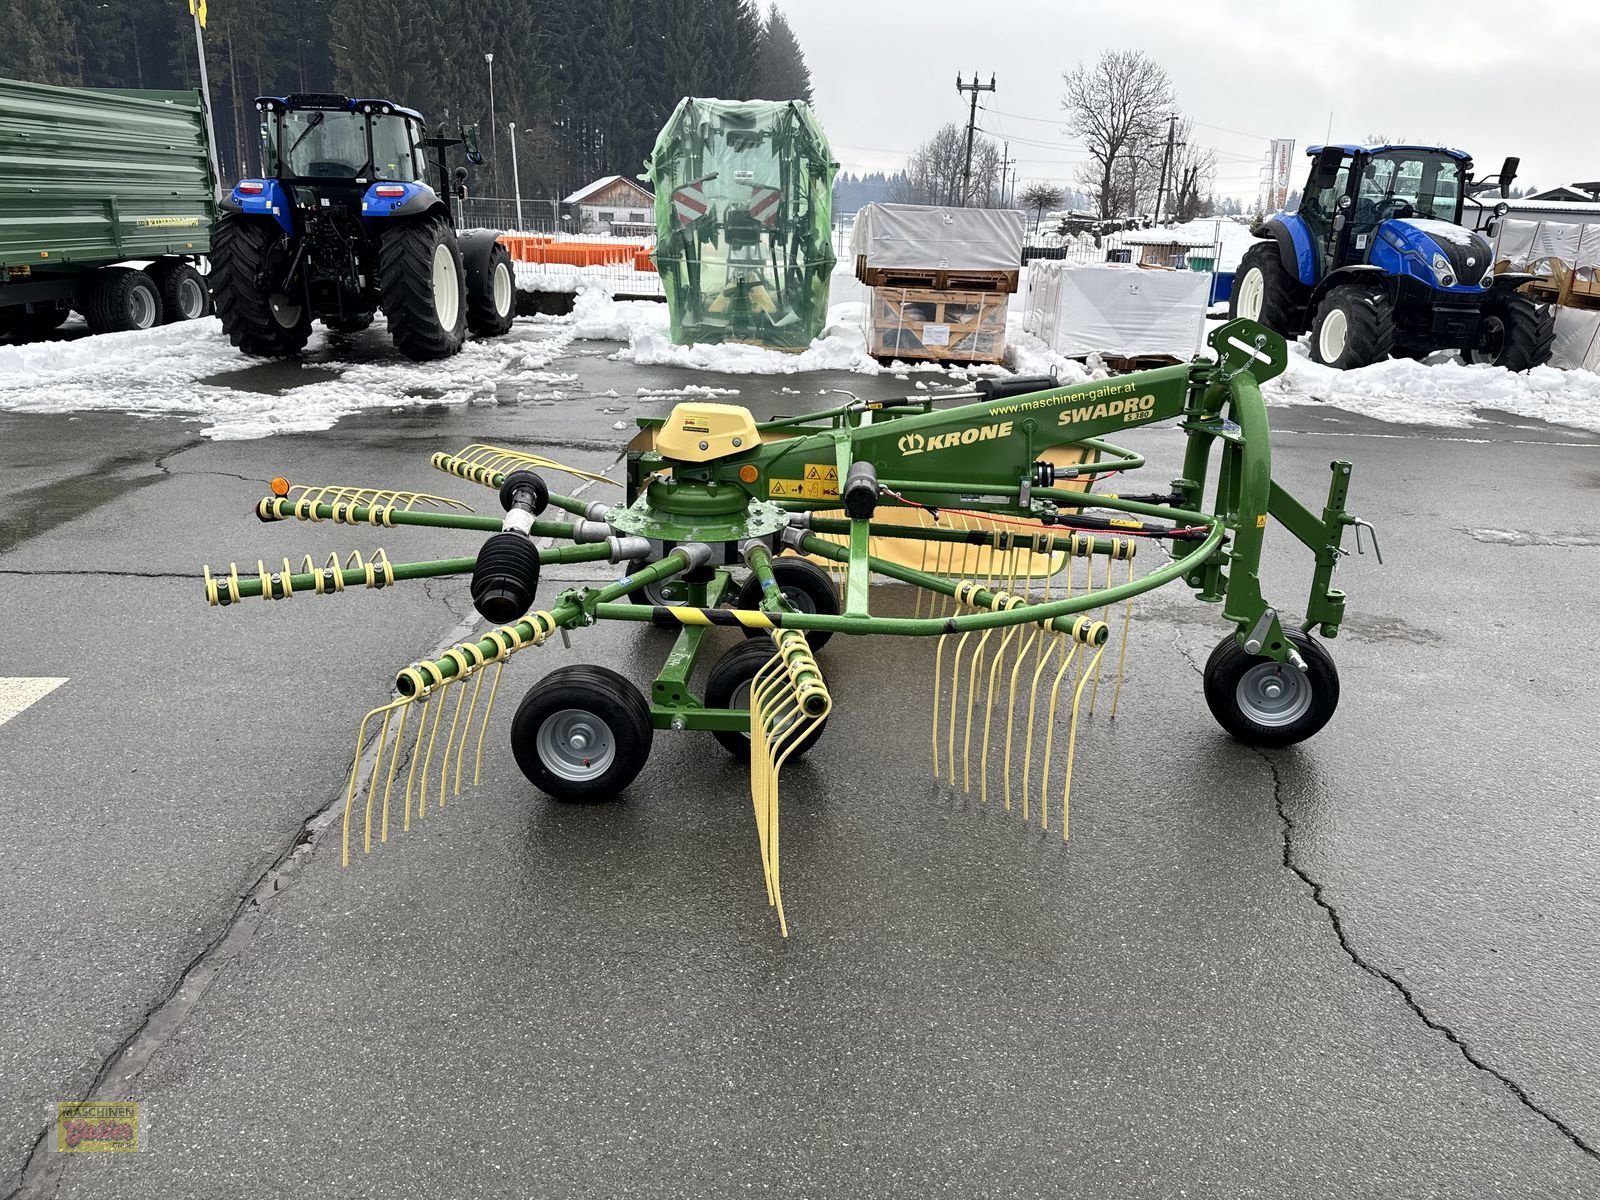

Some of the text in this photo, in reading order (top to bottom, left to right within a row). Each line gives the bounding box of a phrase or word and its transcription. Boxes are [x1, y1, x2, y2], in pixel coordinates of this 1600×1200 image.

[989, 382, 1136, 416] www.maschinen-gailer.at
[1057, 395, 1155, 426] SWADRO
[1134, 410, 1149, 420] 380
[926, 421, 1013, 452] KRONE
